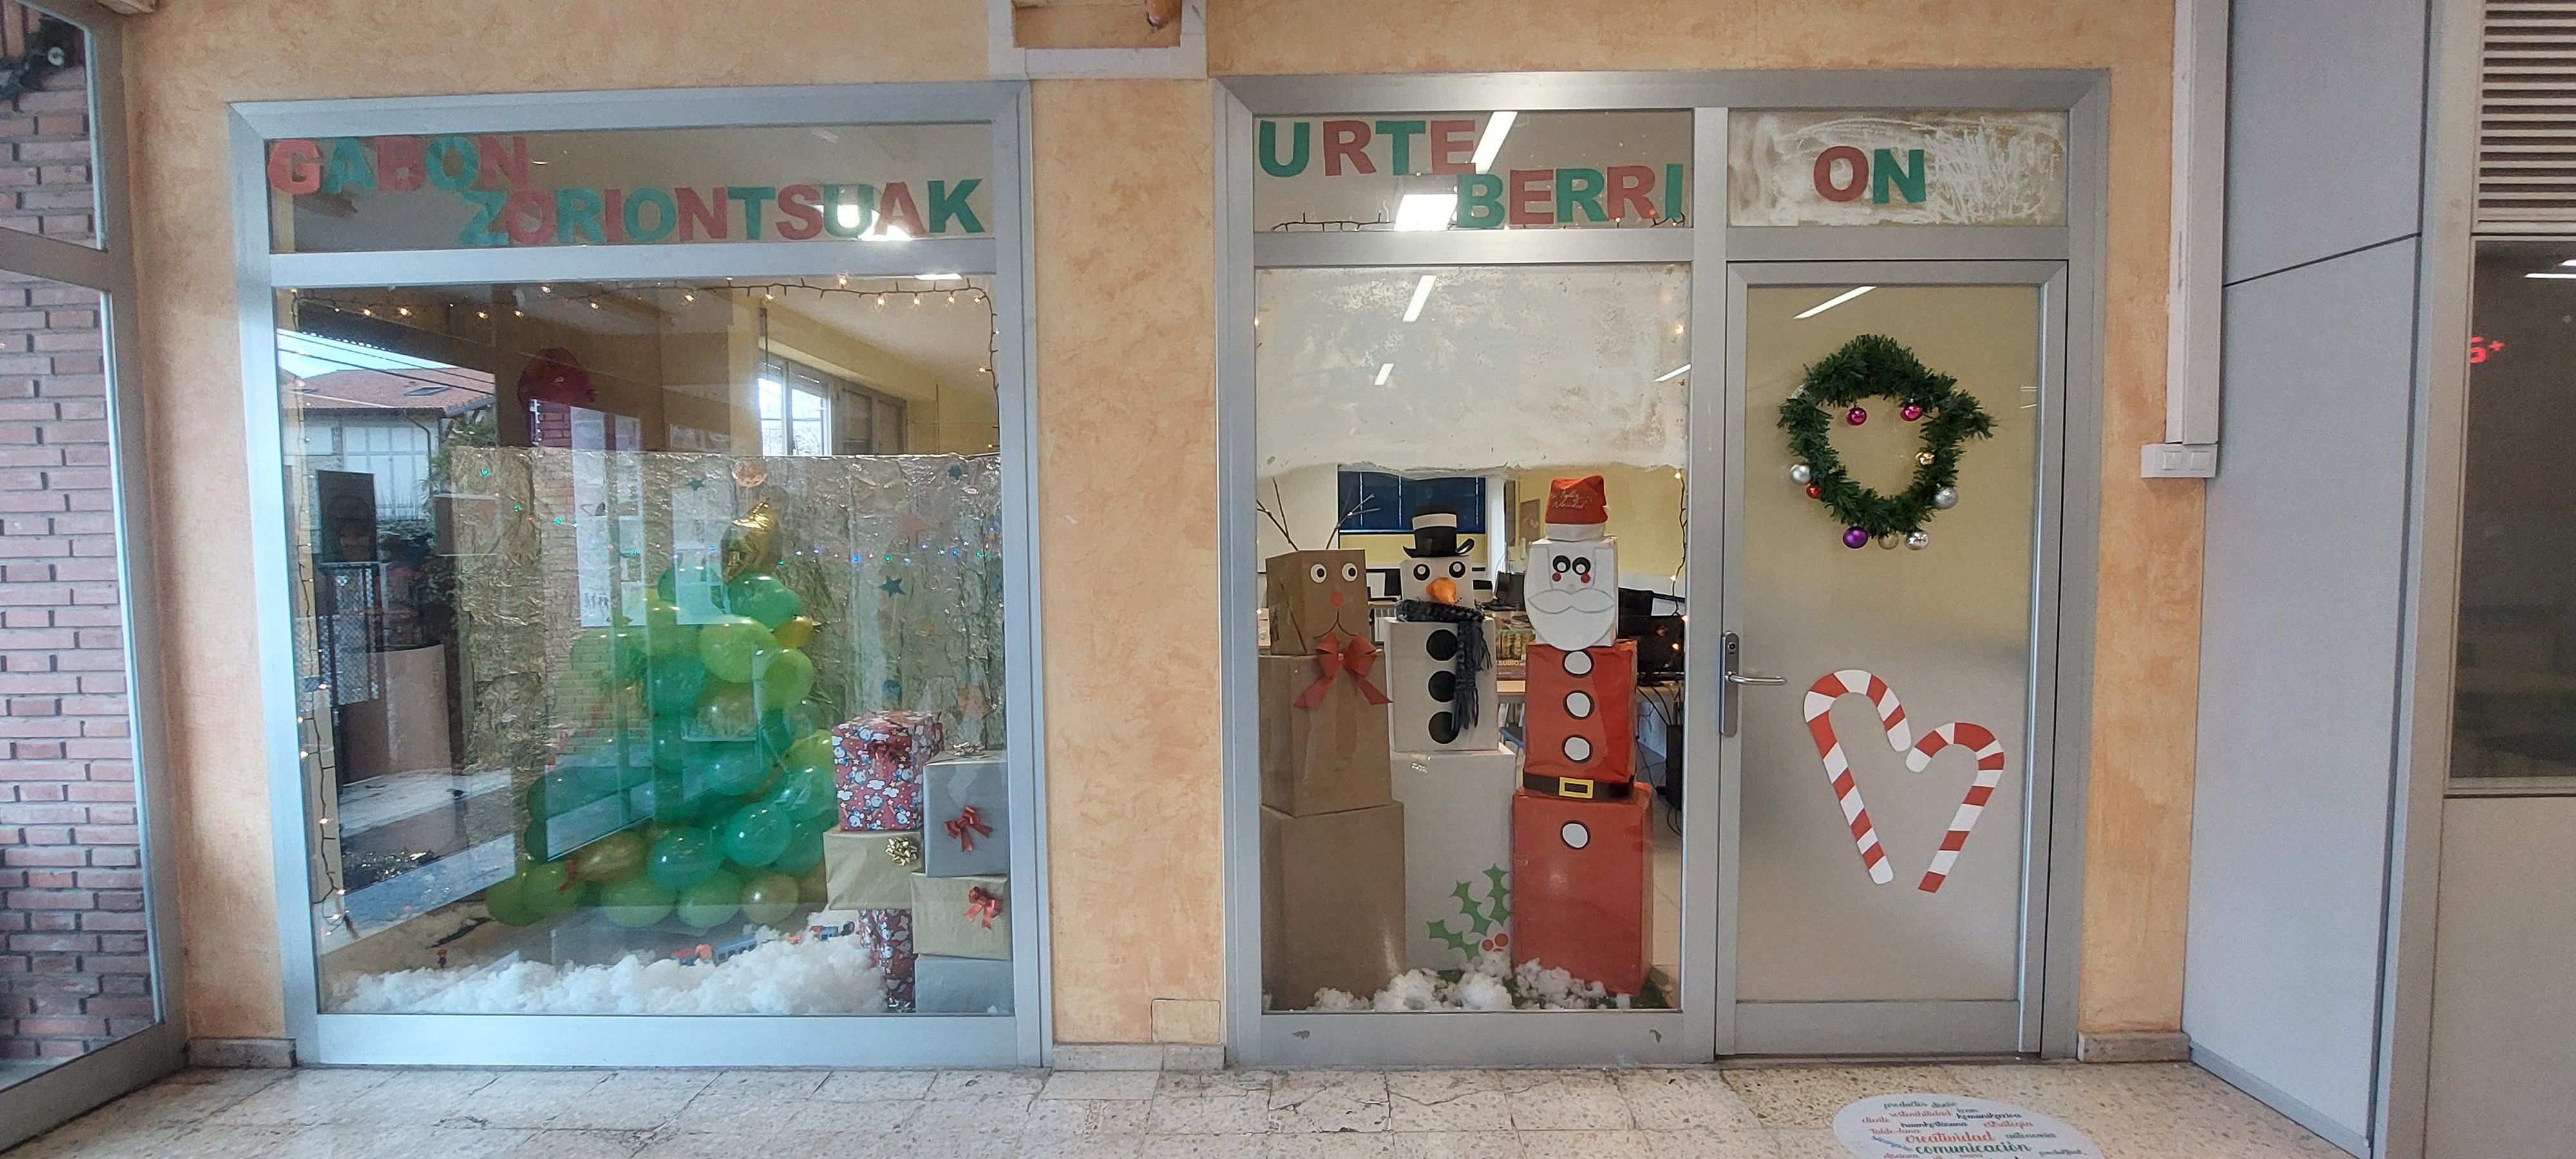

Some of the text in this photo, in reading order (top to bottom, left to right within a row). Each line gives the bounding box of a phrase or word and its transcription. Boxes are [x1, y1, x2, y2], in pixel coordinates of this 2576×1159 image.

[267, 135, 530, 193] GABON
[1258, 120, 1476, 177] URTE
[1814, 146, 1927, 204] ON
[458, 178, 985, 246] ZORIONTSUAK
[1455, 163, 1683, 228] BERRI
[1915, 1141, 2032, 1154] comunicación
